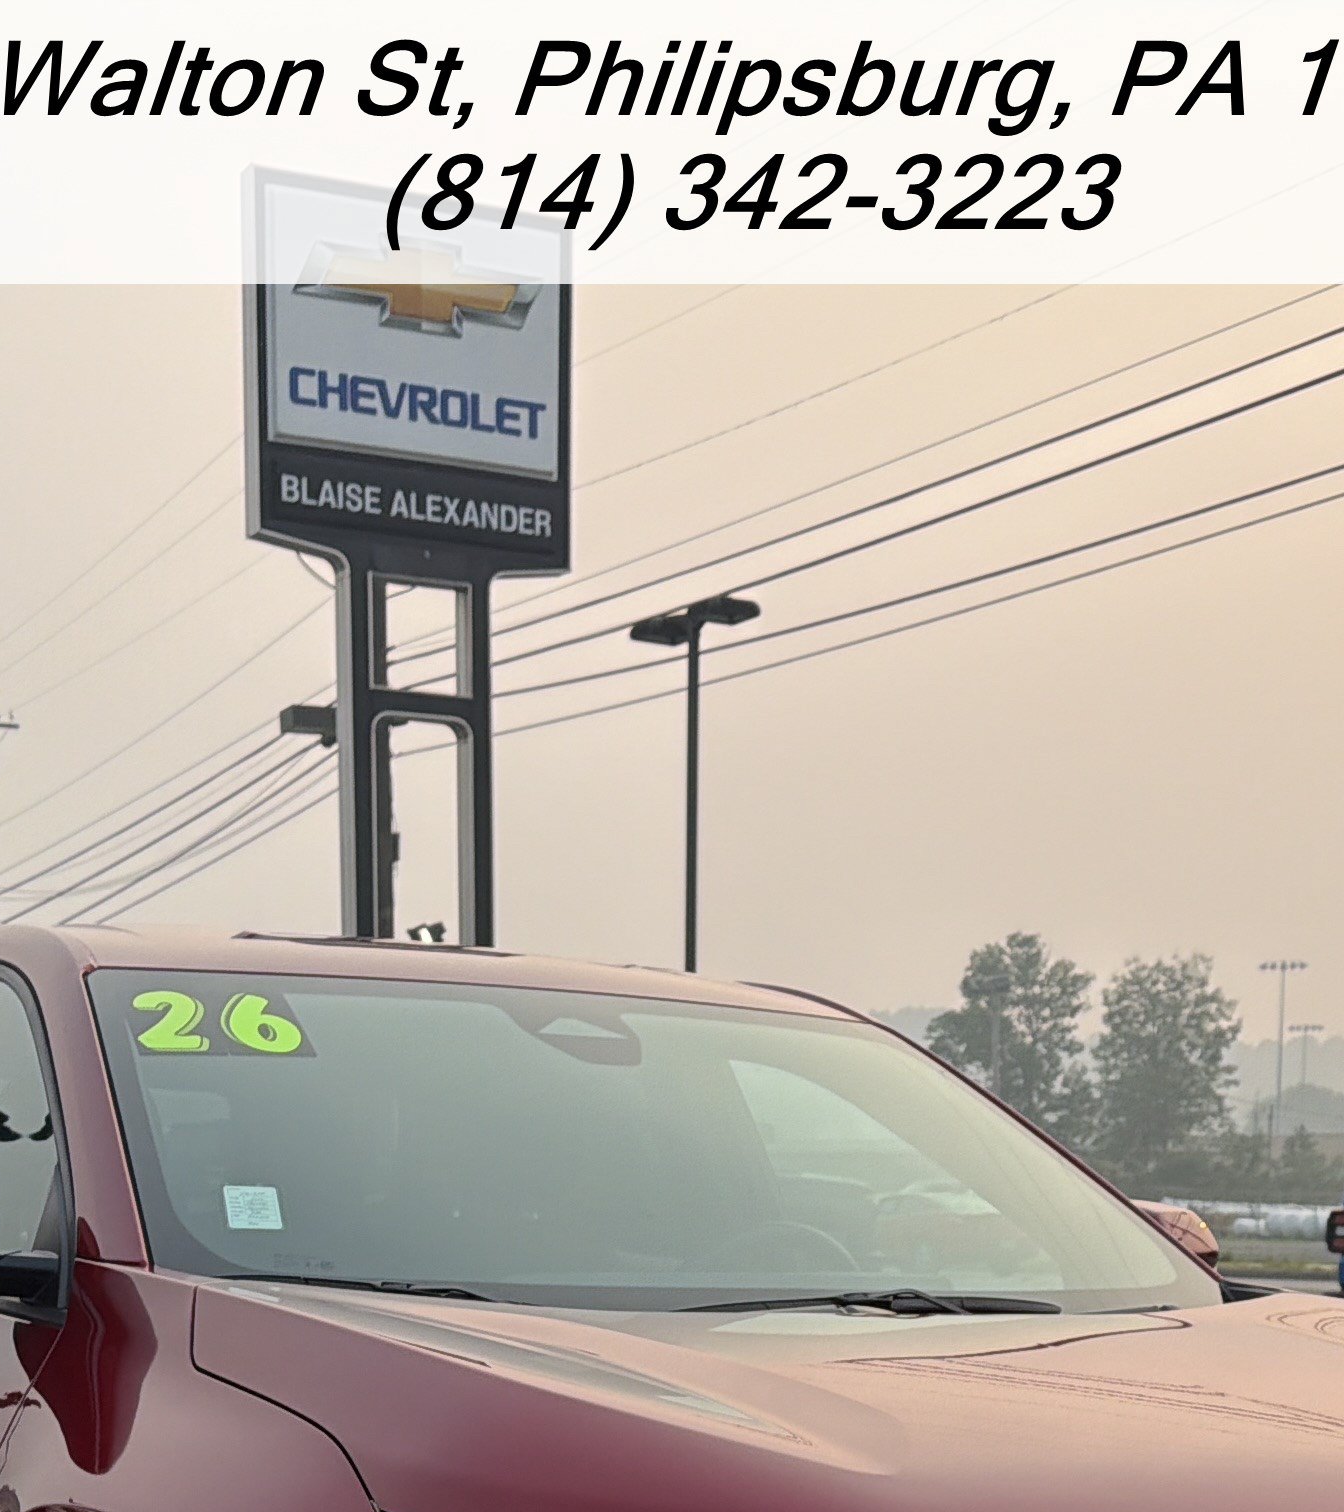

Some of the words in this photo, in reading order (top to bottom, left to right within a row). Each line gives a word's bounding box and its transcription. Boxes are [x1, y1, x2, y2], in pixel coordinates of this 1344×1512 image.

[288, 365, 548, 440] CHEVROLET
[279, 472, 383, 516] BLAISE
[389, 489, 554, 538] ALEXANDER
[131, 989, 303, 1054] 26
